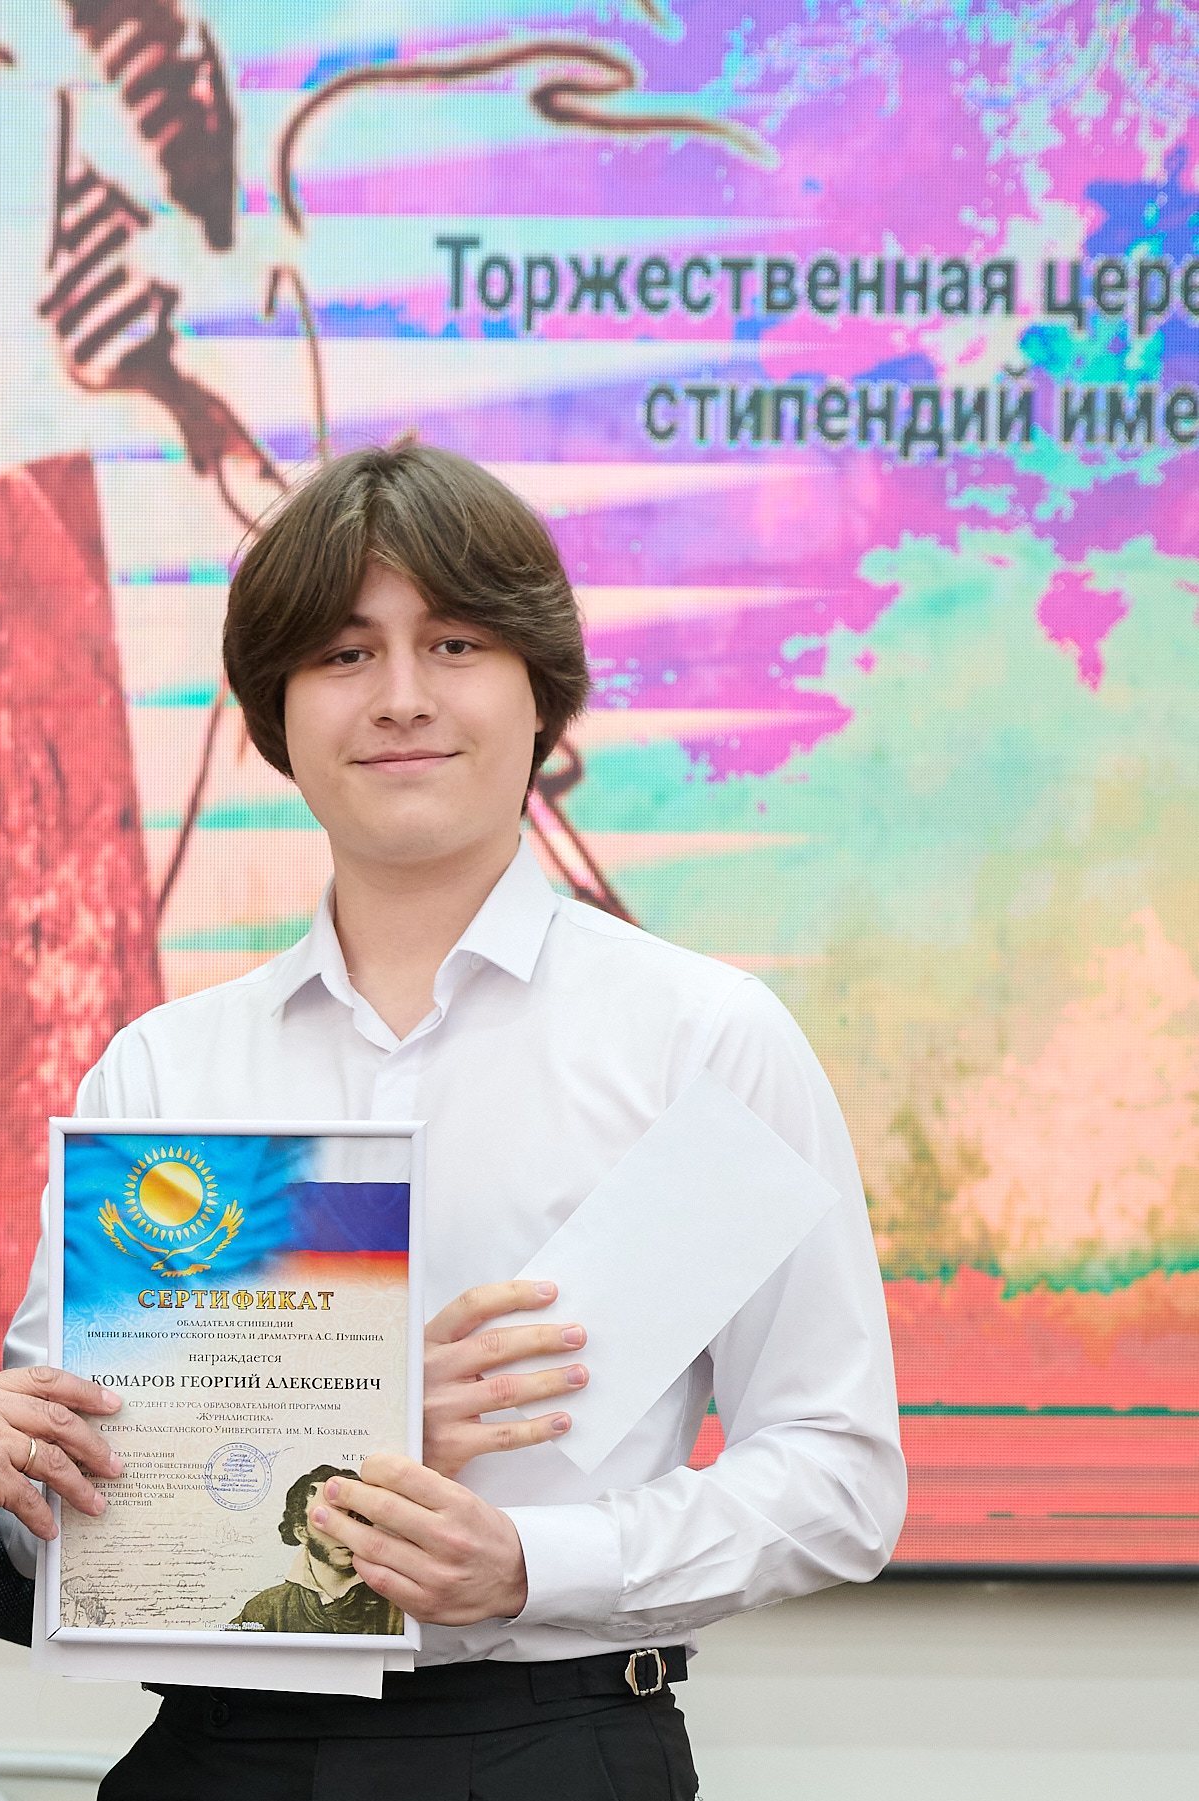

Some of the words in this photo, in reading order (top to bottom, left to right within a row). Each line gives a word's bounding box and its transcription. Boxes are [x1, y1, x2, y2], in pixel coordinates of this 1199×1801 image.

[436, 235, 1014, 333] Торжественная
[644, 364, 1032, 459] стипендий
[137, 1289, 335, 1311] СЕРТИФИКАТ
[176, 1319, 235, 1328] ОБЛАДАТЕЛЯ
[236, 1320, 294, 1329] СТИПЕНДИИ
[121, 1331, 169, 1339] ВЕЛИКОГО
[170, 1332, 215, 1340] РУССКОГО
[217, 1332, 247, 1340] ПОЭТА
[257, 1333, 314, 1341] ДРАМАТУРГА
[315, 1332, 334, 1341] А.С.
[188, 1353, 282, 1366] награждается
[91, 1374, 175, 1388] КОМАРОВ
[180, 1373, 261, 1389] ГЕОРГИЙ
[265, 1376, 381, 1391] АЛЕКСЕЕВИЧ
[128, 1400, 168, 1409] СТУДЕНТ
[176, 1401, 202, 1409] КУРСА
[203, 1401, 287, 1410] ОБРАЗОВАТЕЛЬНОЙ
[288, 1402, 341, 1411] ПРОГРАММЫ
[303, 1426, 315, 1436] М.
